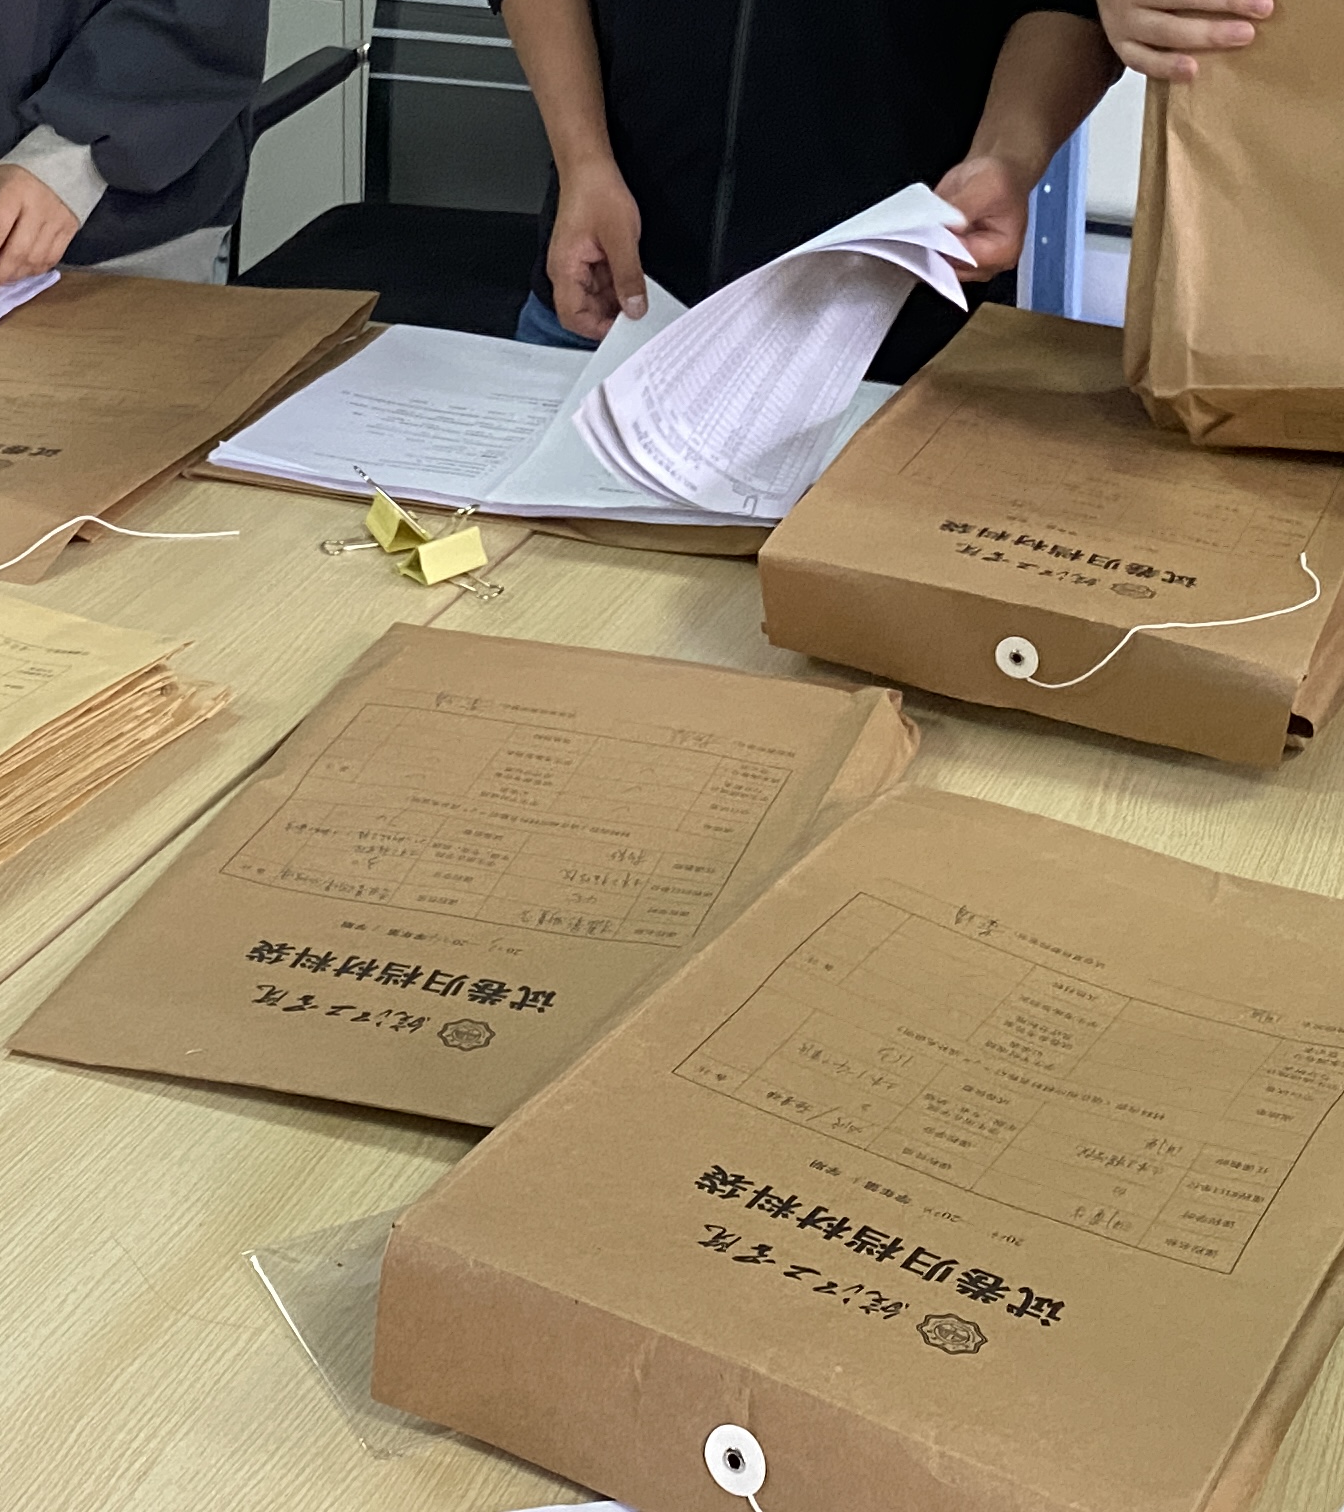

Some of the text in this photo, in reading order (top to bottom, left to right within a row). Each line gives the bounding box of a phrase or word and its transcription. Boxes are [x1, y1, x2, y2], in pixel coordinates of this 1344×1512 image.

[938, 520, 1198, 587] 试卷归档材料袋
[247, 940, 556, 1011] 试卷归档材料袋
[696, 1167, 1063, 1323] 试卷归档材料袋
